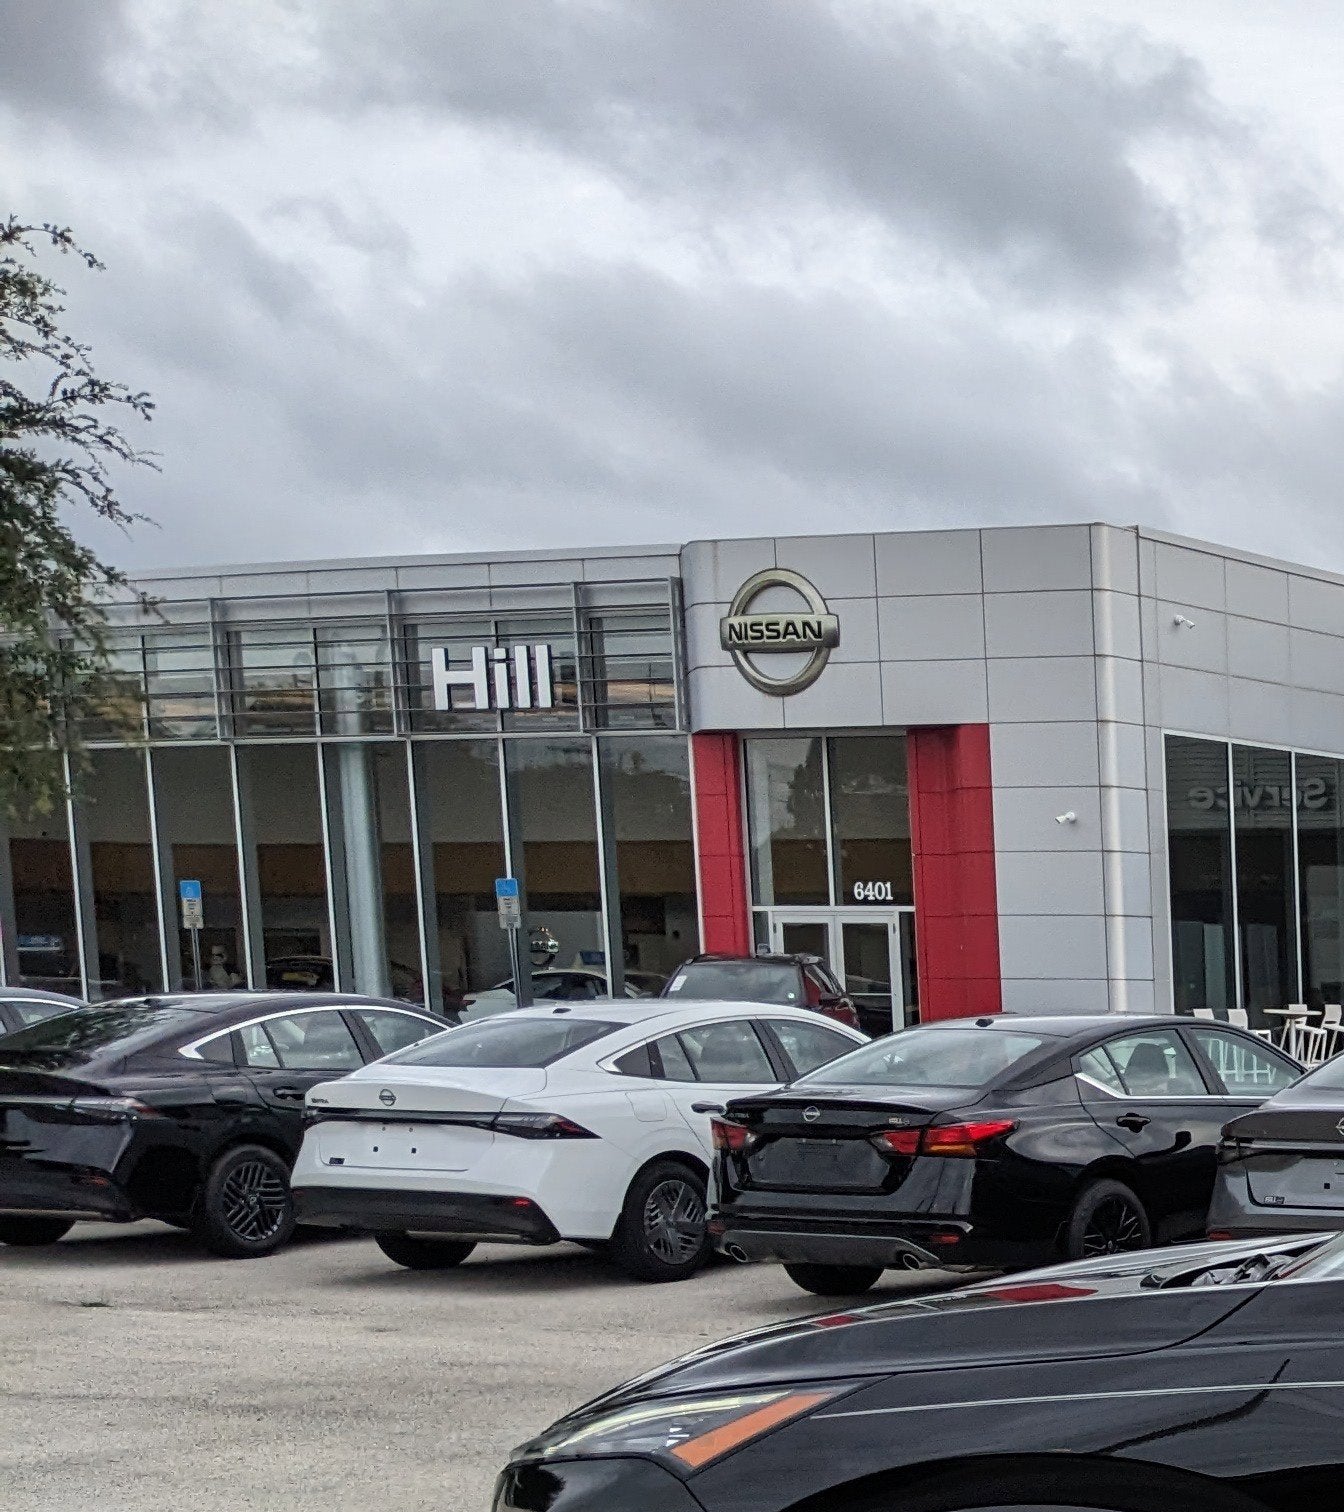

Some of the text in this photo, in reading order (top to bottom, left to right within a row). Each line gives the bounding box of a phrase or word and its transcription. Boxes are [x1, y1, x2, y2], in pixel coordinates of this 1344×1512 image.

[727, 620, 823, 641] NISSAN
[431, 644, 553, 711] Hill
[853, 881, 894, 901] 6401
